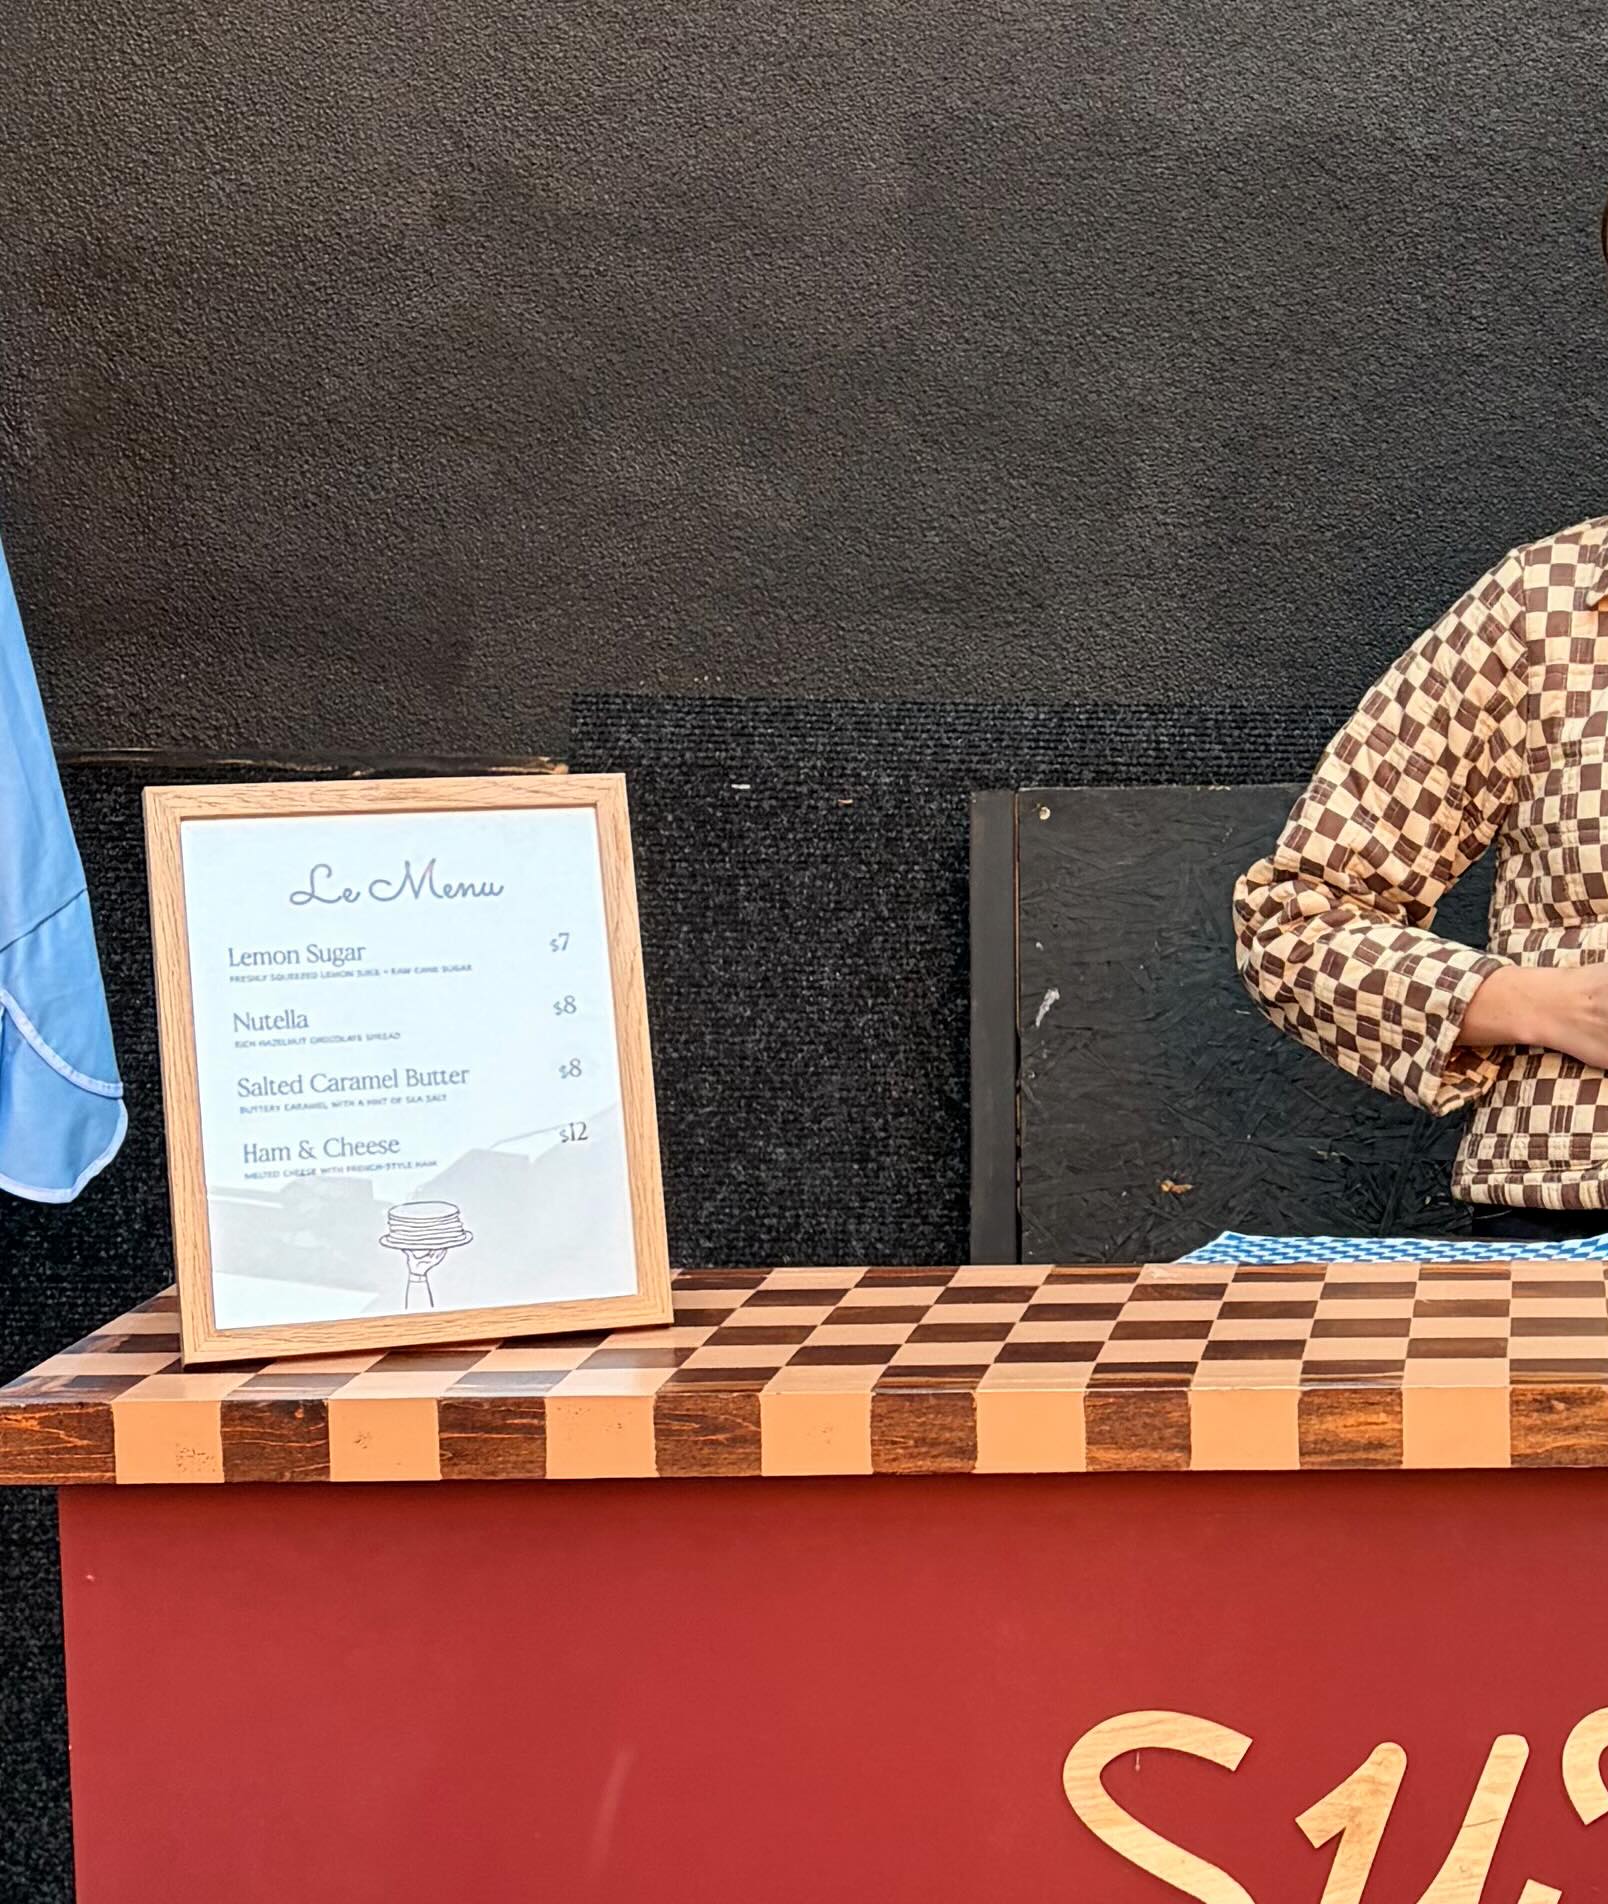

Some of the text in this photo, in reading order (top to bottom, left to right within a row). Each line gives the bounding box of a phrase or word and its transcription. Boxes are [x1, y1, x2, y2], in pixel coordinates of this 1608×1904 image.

[290, 857, 505, 906] Le Menu
[550, 932, 570, 953] $7
[228, 943, 367, 968] Lemon Sugar
[553, 995, 577, 1016] $8
[233, 1008, 310, 1033] Nutella
[558, 1058, 582, 1079] $8
[237, 1067, 471, 1099] Salted Caramel Butter
[559, 1121, 588, 1143] $12
[243, 1136, 401, 1165] Ham & Cheese
